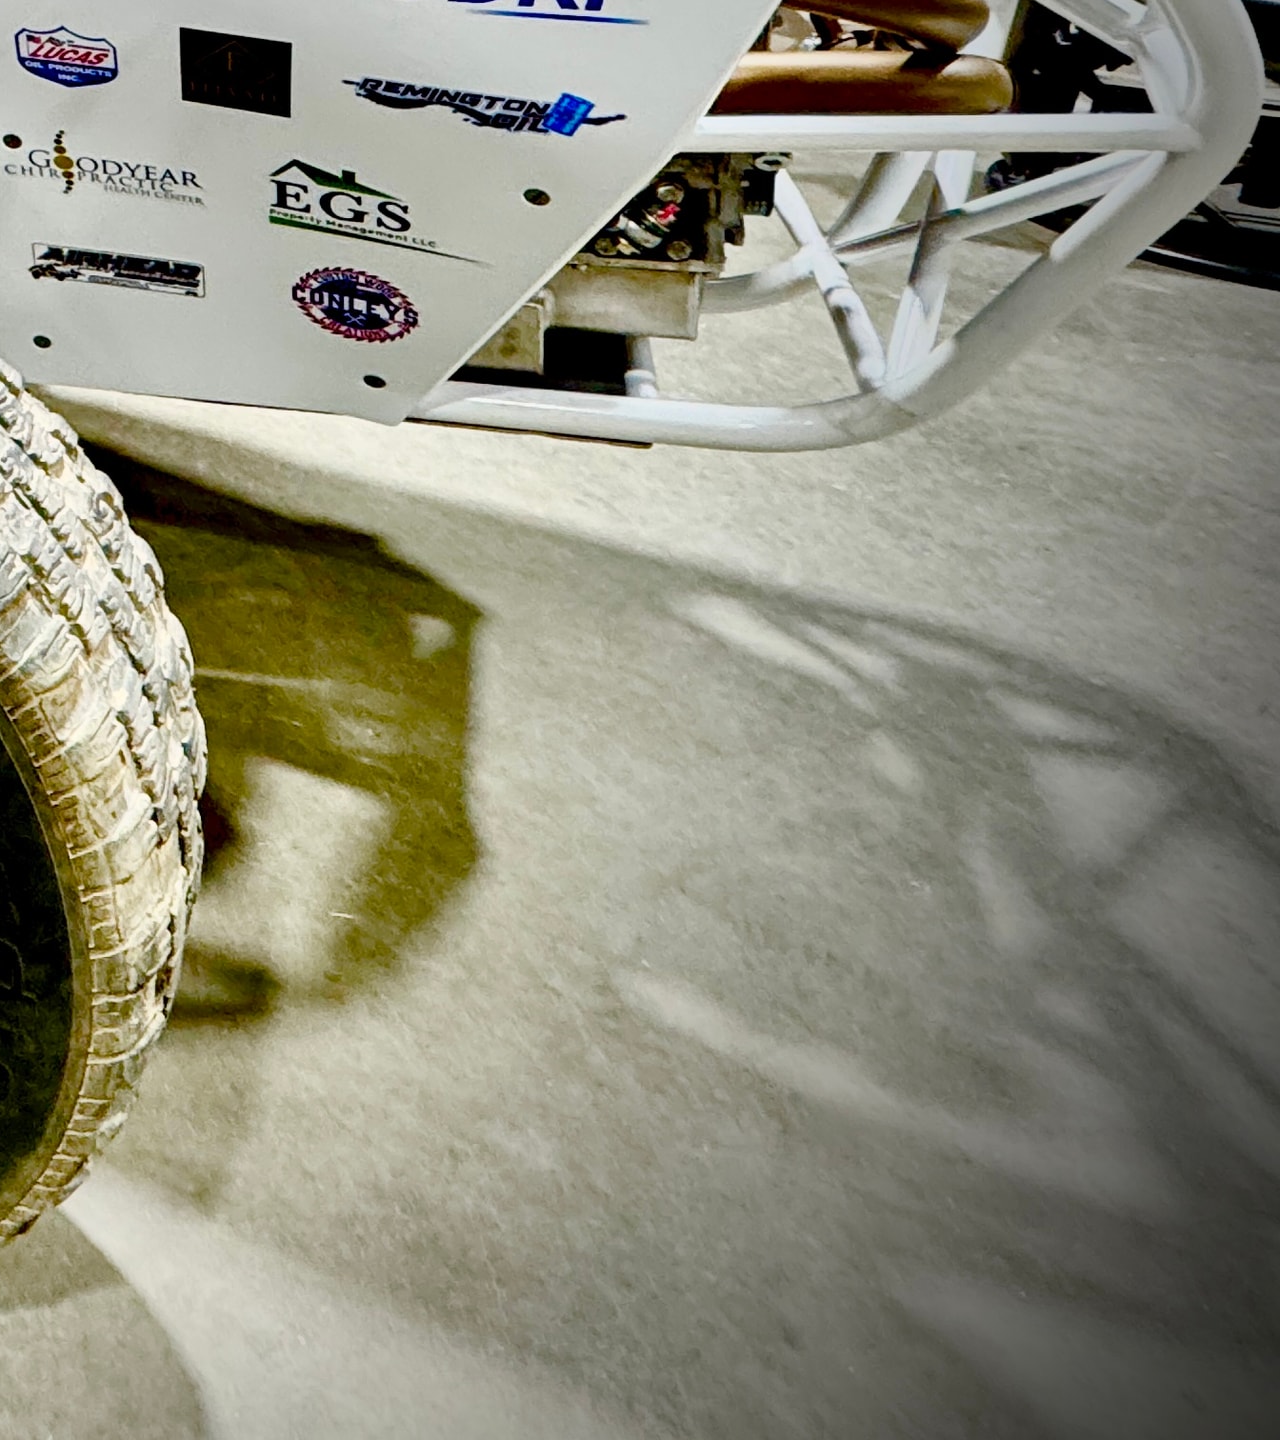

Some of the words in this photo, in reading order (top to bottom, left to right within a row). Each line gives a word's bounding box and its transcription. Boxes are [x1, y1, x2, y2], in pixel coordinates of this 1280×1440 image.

[25, 60, 44, 70] OIL
[48, 63, 113, 78] PRODUCTS
[28, 45, 109, 66] LUCAS
[358, 77, 552, 115] REMINGTON
[104, 184, 151, 198] HEALTH
[154, 191, 205, 206] CENTER
[269, 178, 412, 233] EGS
[269, 208, 322, 225] Property
[326, 219, 408, 242] Management
[412, 237, 437, 249] LLC
